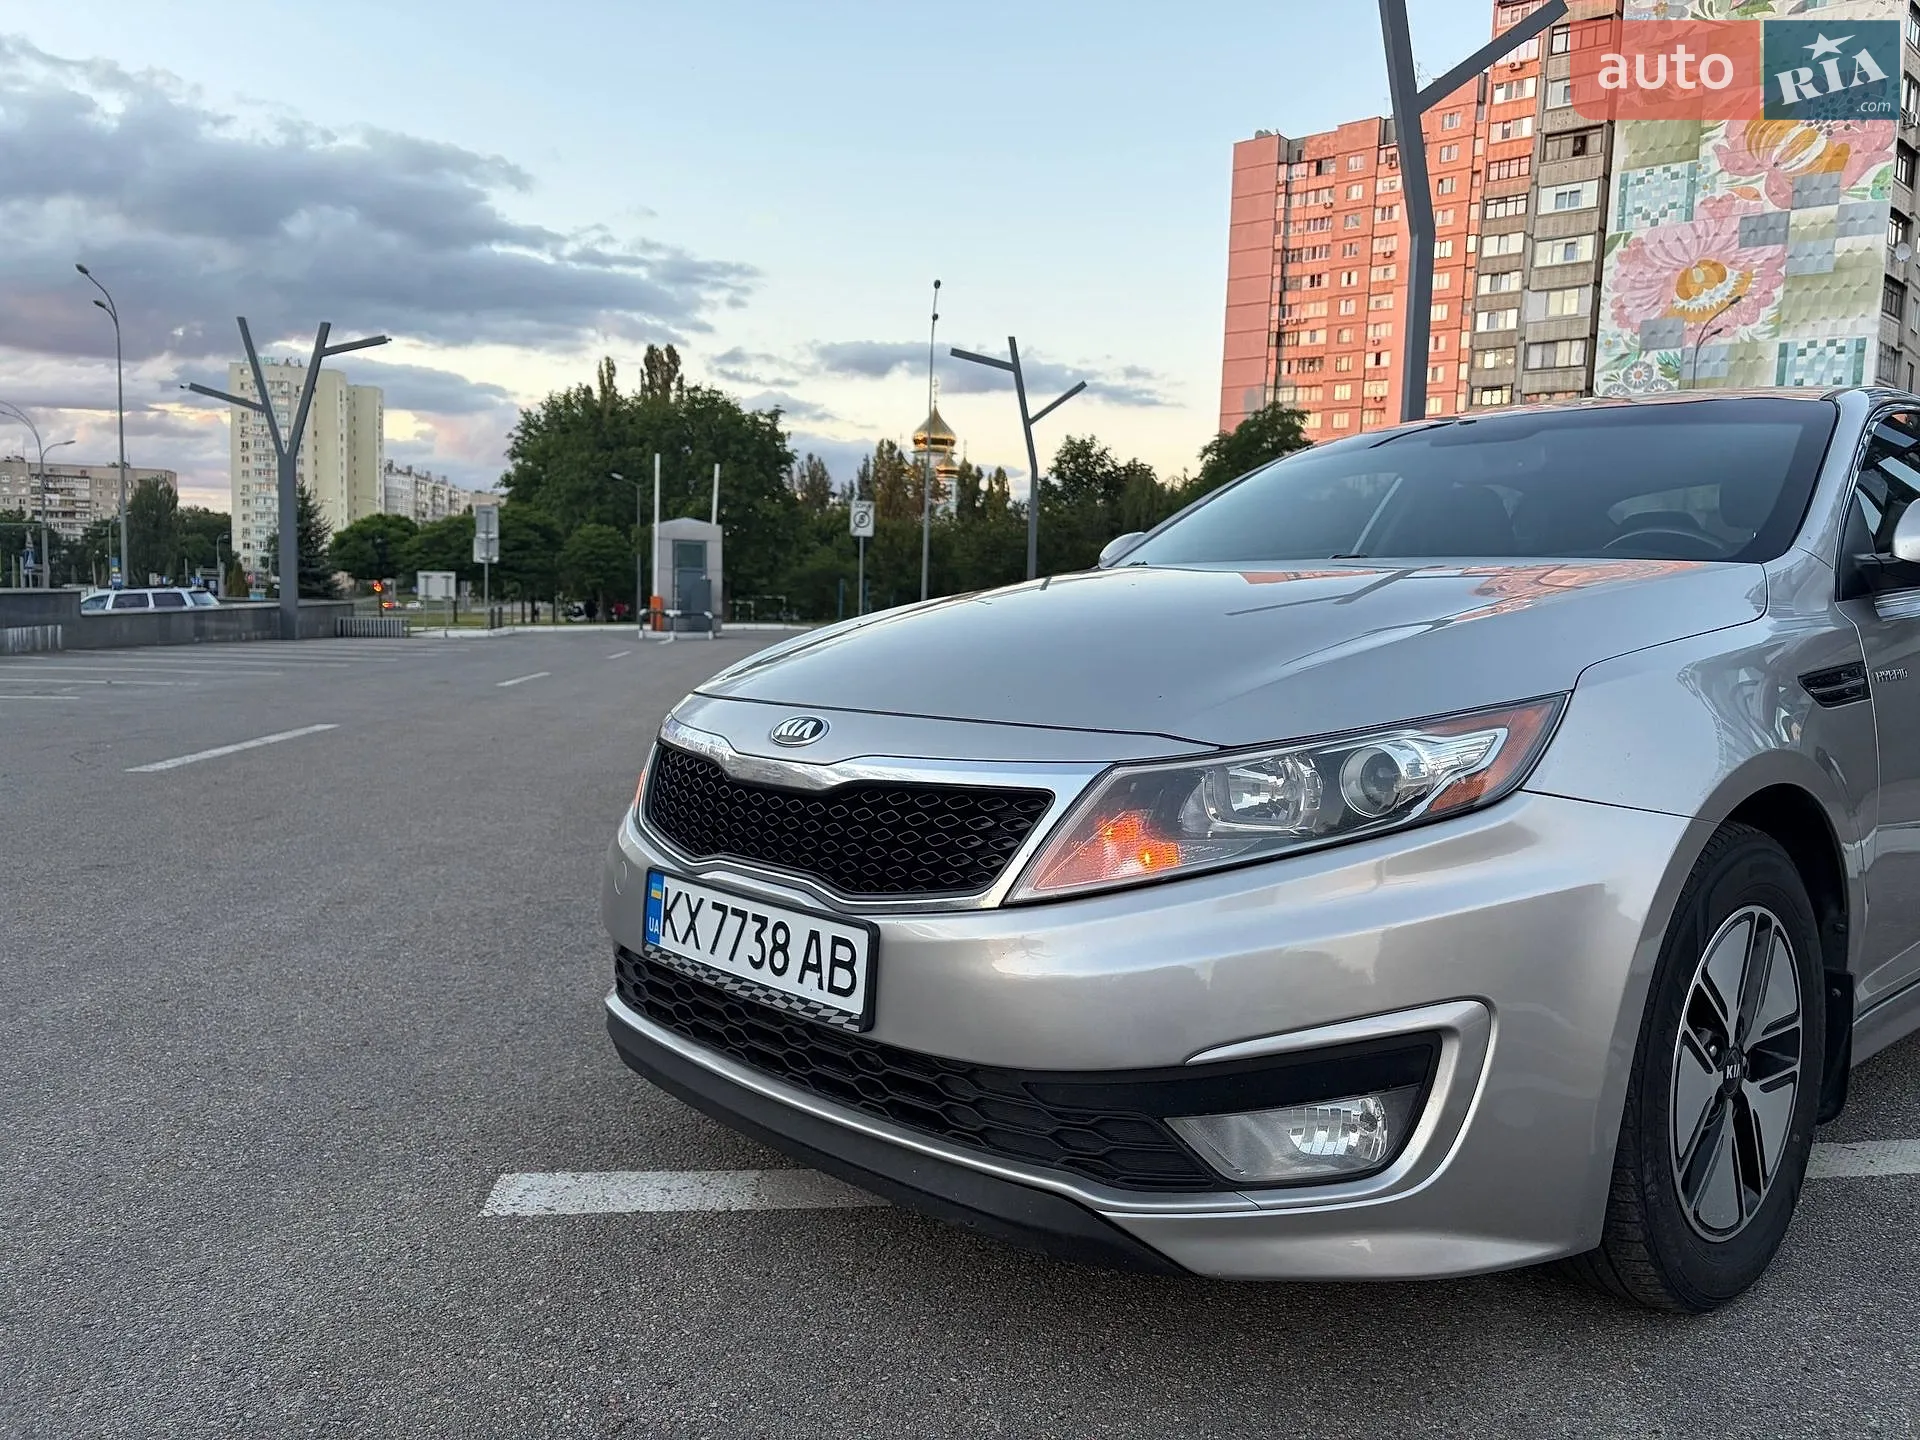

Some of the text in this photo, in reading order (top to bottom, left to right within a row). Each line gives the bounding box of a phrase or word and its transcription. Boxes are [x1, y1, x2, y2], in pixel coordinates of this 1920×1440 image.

[774, 719, 817, 739] KIA
[648, 916, 660, 934] UA
[662, 886, 858, 998] KX 7738 AB
